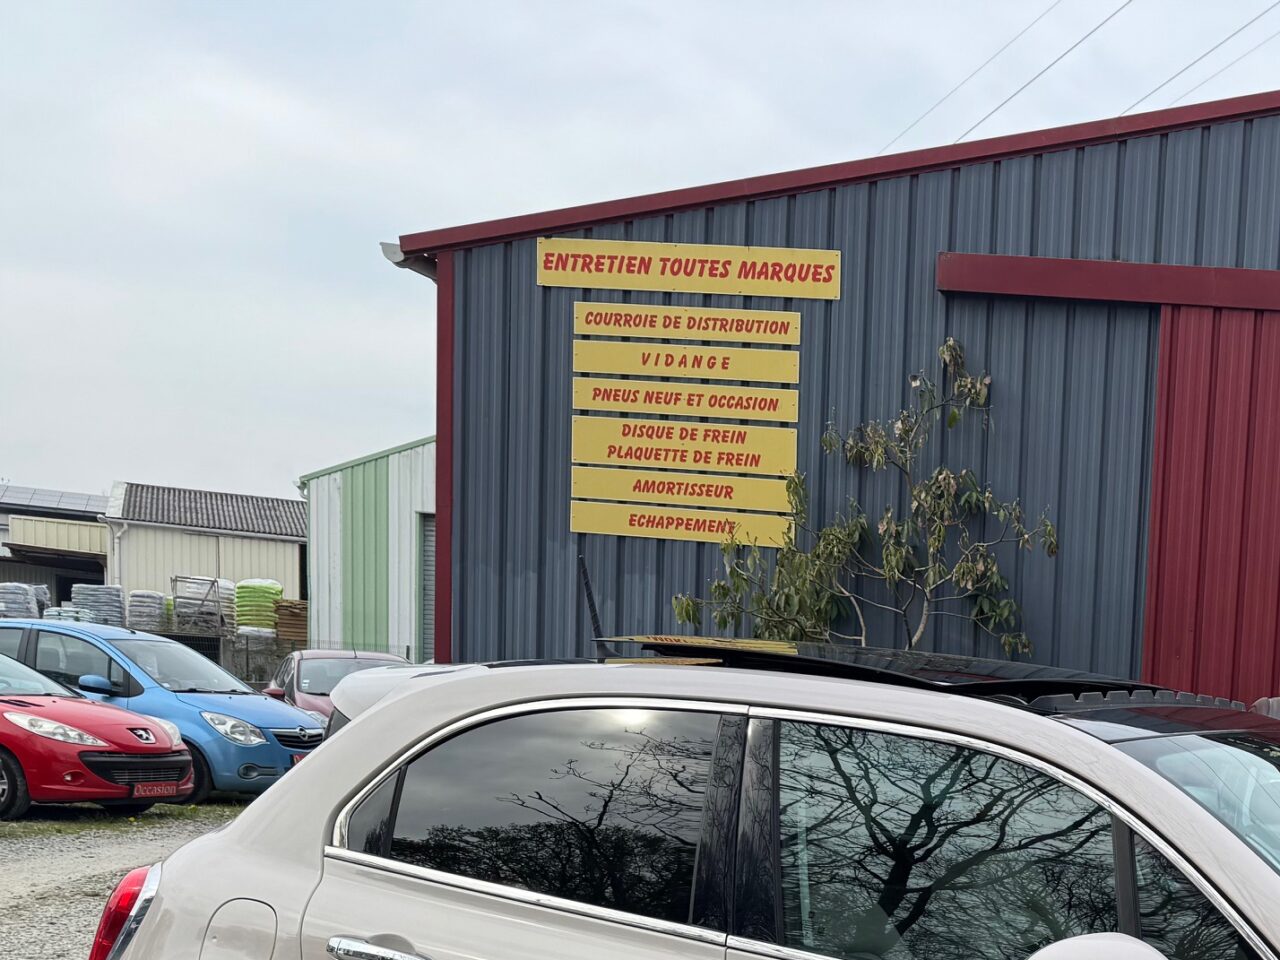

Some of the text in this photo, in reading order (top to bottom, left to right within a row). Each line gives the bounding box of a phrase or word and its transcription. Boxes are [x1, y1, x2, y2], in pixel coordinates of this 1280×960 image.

[543, 252, 836, 284] ENTRETIEN TOUTES MARQUES
[584, 311, 790, 335] COURROIE DE DISTRIBUTION
[592, 387, 780, 413] PNEUS NEUF ET OCCASION
[621, 423, 747, 445] DISQUE DE FREIN
[607, 445, 761, 468] PLAQUETTE DE FREIN
[632, 479, 734, 499] AMORTISSEUR
[628, 513, 735, 534] ECHAPPEMENT
[135, 783, 177, 797] Occasion
